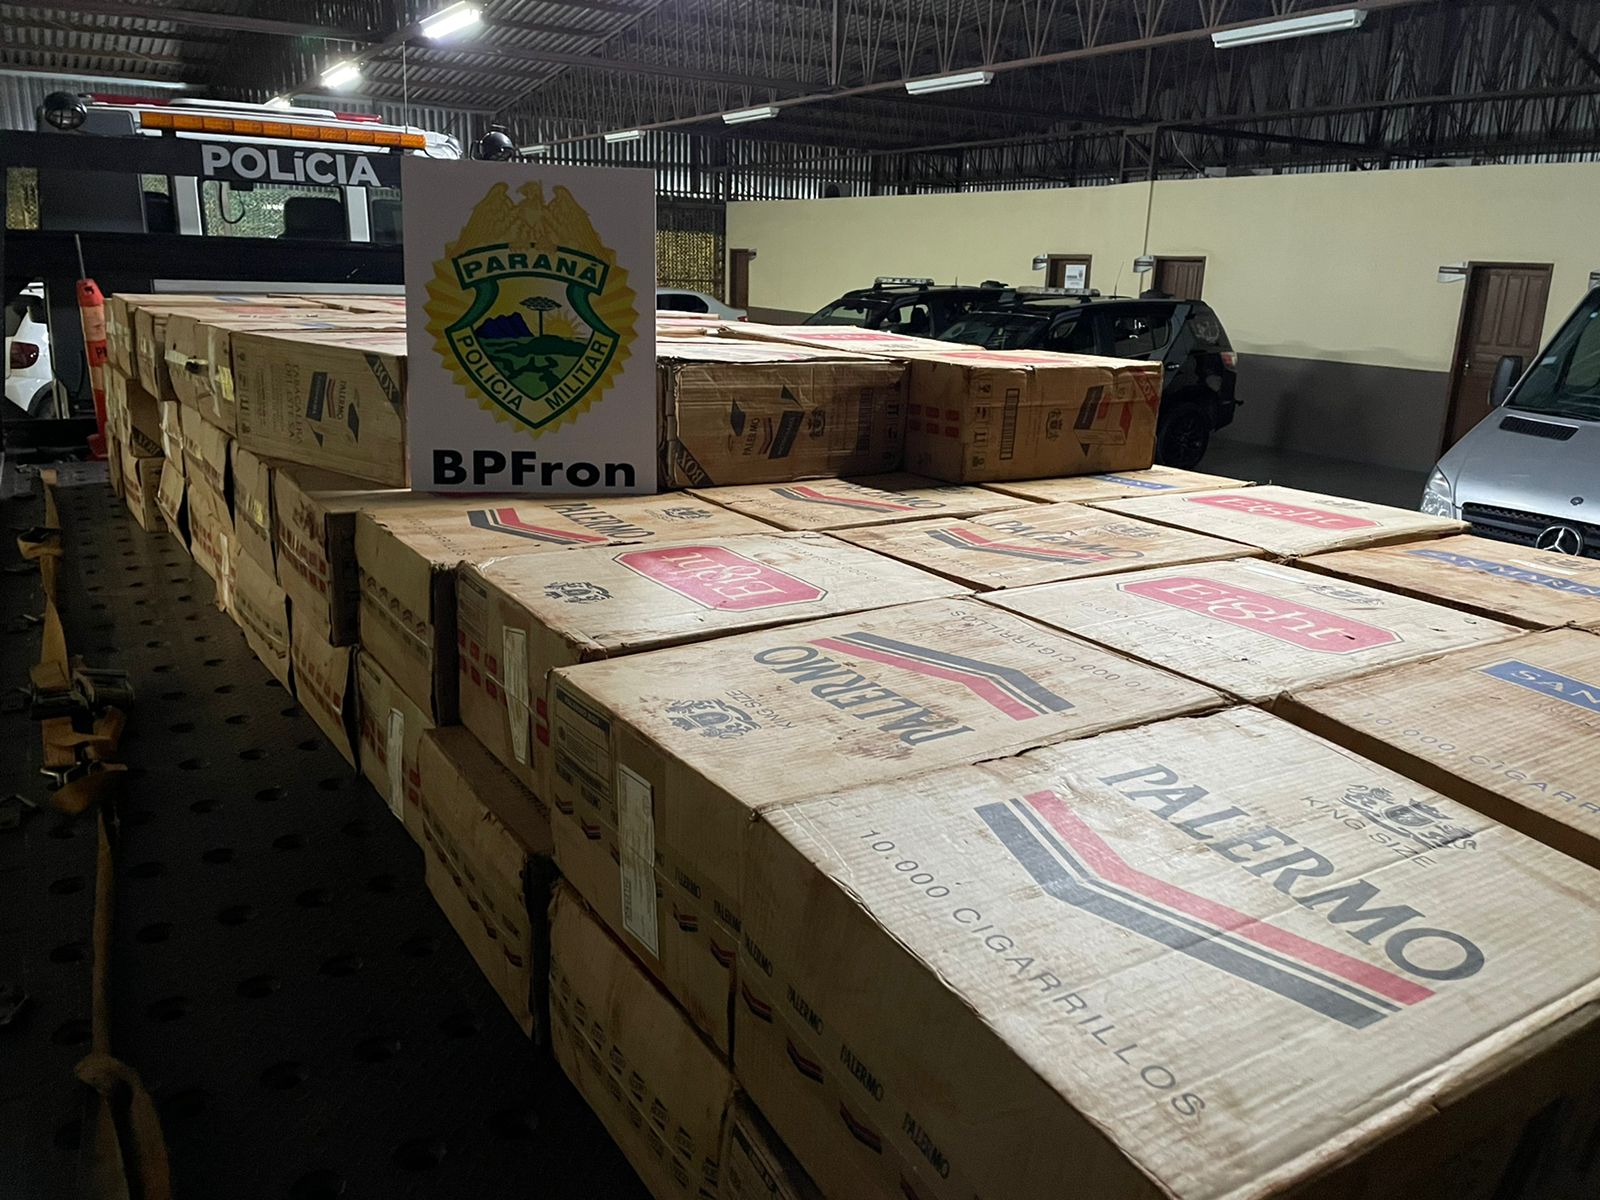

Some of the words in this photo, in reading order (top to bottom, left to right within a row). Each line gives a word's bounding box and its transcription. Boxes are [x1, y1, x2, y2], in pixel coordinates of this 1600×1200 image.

[464, 253, 597, 284] PARANÁ
[336, 380, 347, 421] PALERMO
[372, 359, 397, 399] BOX
[457, 335, 523, 411] POLÍCIA
[544, 339, 609, 411] MILITAR
[433, 449, 635, 487] BPFron
[1222, 498, 1341, 524] Eight
[661, 551, 788, 601] Eight
[1161, 581, 1353, 641] Eight
[753, 646, 975, 746] PALERMO
[1300, 796, 1367, 831] KING
[1368, 832, 1438, 869] SIZE
[1100, 762, 1487, 982] PALERMO
[860, 830, 950, 898] 10.000
[953, 908, 1207, 1119] CIGARRILLOS
[840, 1044, 885, 1102] PALERMO
[902, 1112, 950, 1179] PALERMO
